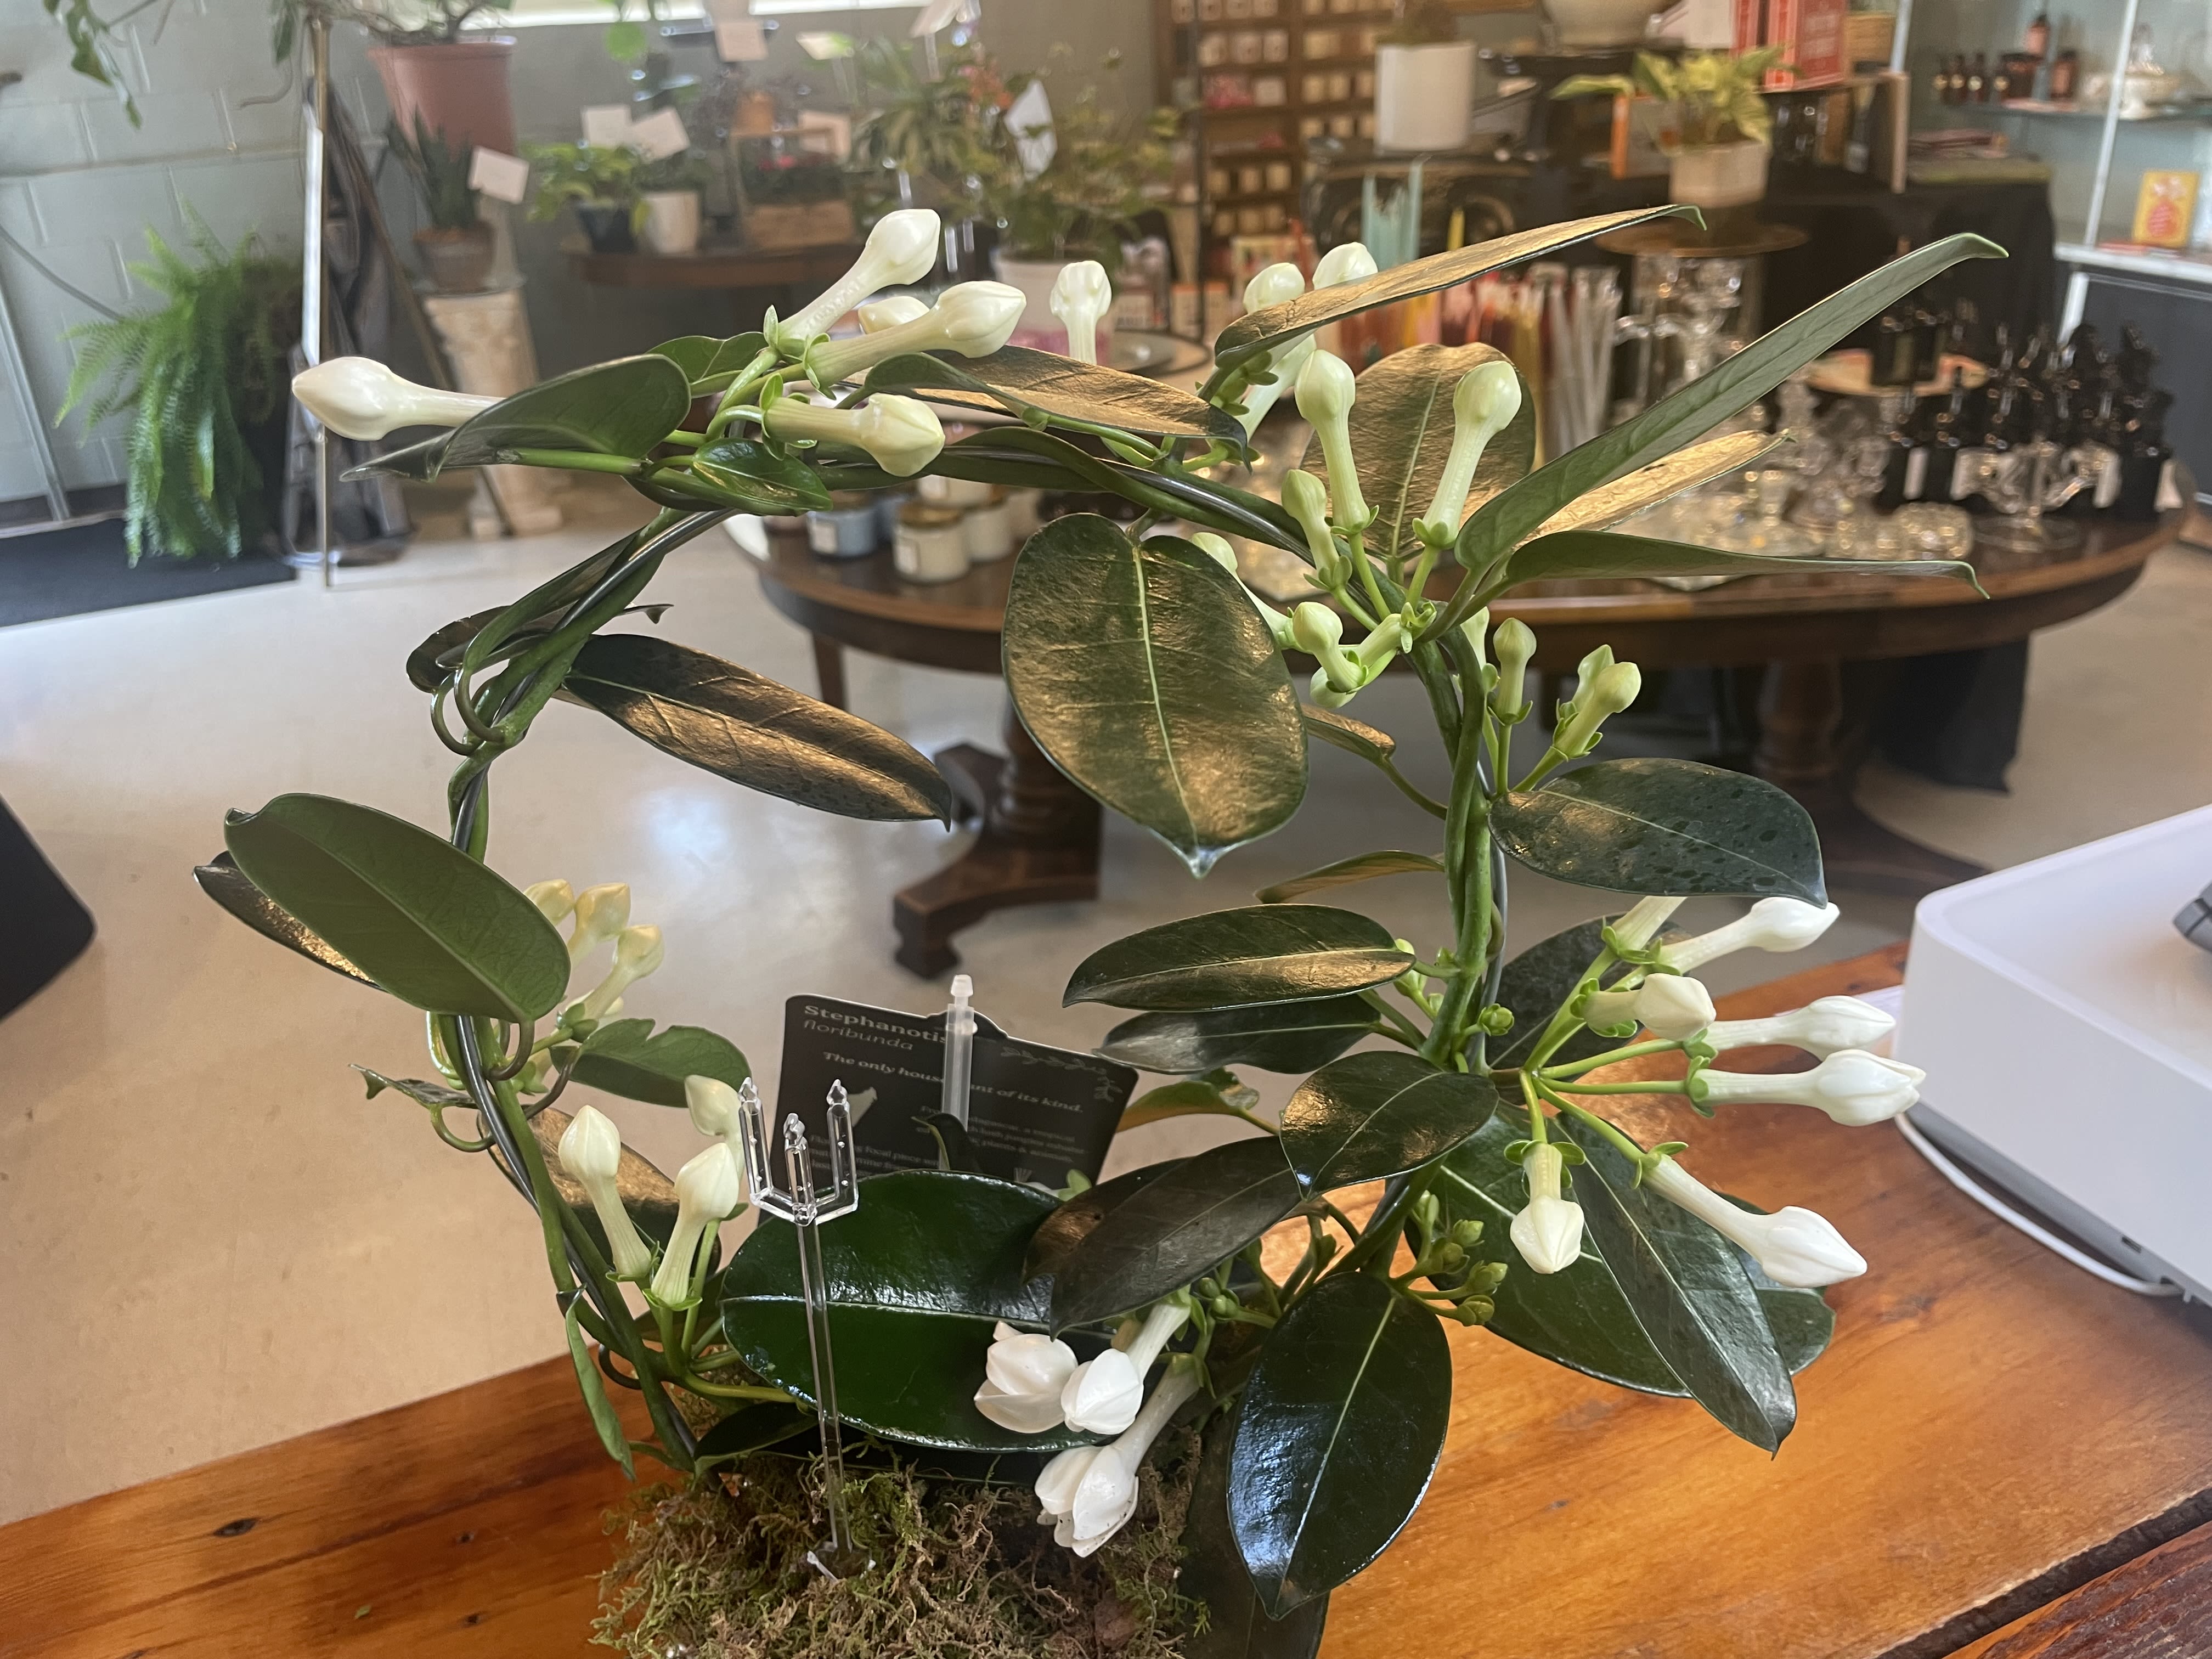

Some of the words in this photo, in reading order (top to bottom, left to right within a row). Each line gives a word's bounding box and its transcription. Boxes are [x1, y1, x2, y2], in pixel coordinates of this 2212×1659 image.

[804, 1005, 946, 1043] Stephanotis
[804, 1019, 913, 1050] floribunda
[823, 1051, 855, 1065] The
[858, 1060, 895, 1074] only
[996, 1089, 1017, 1097] of
[1017, 1092, 1039, 1103] its
[1042, 1097, 1084, 1113] kind.
